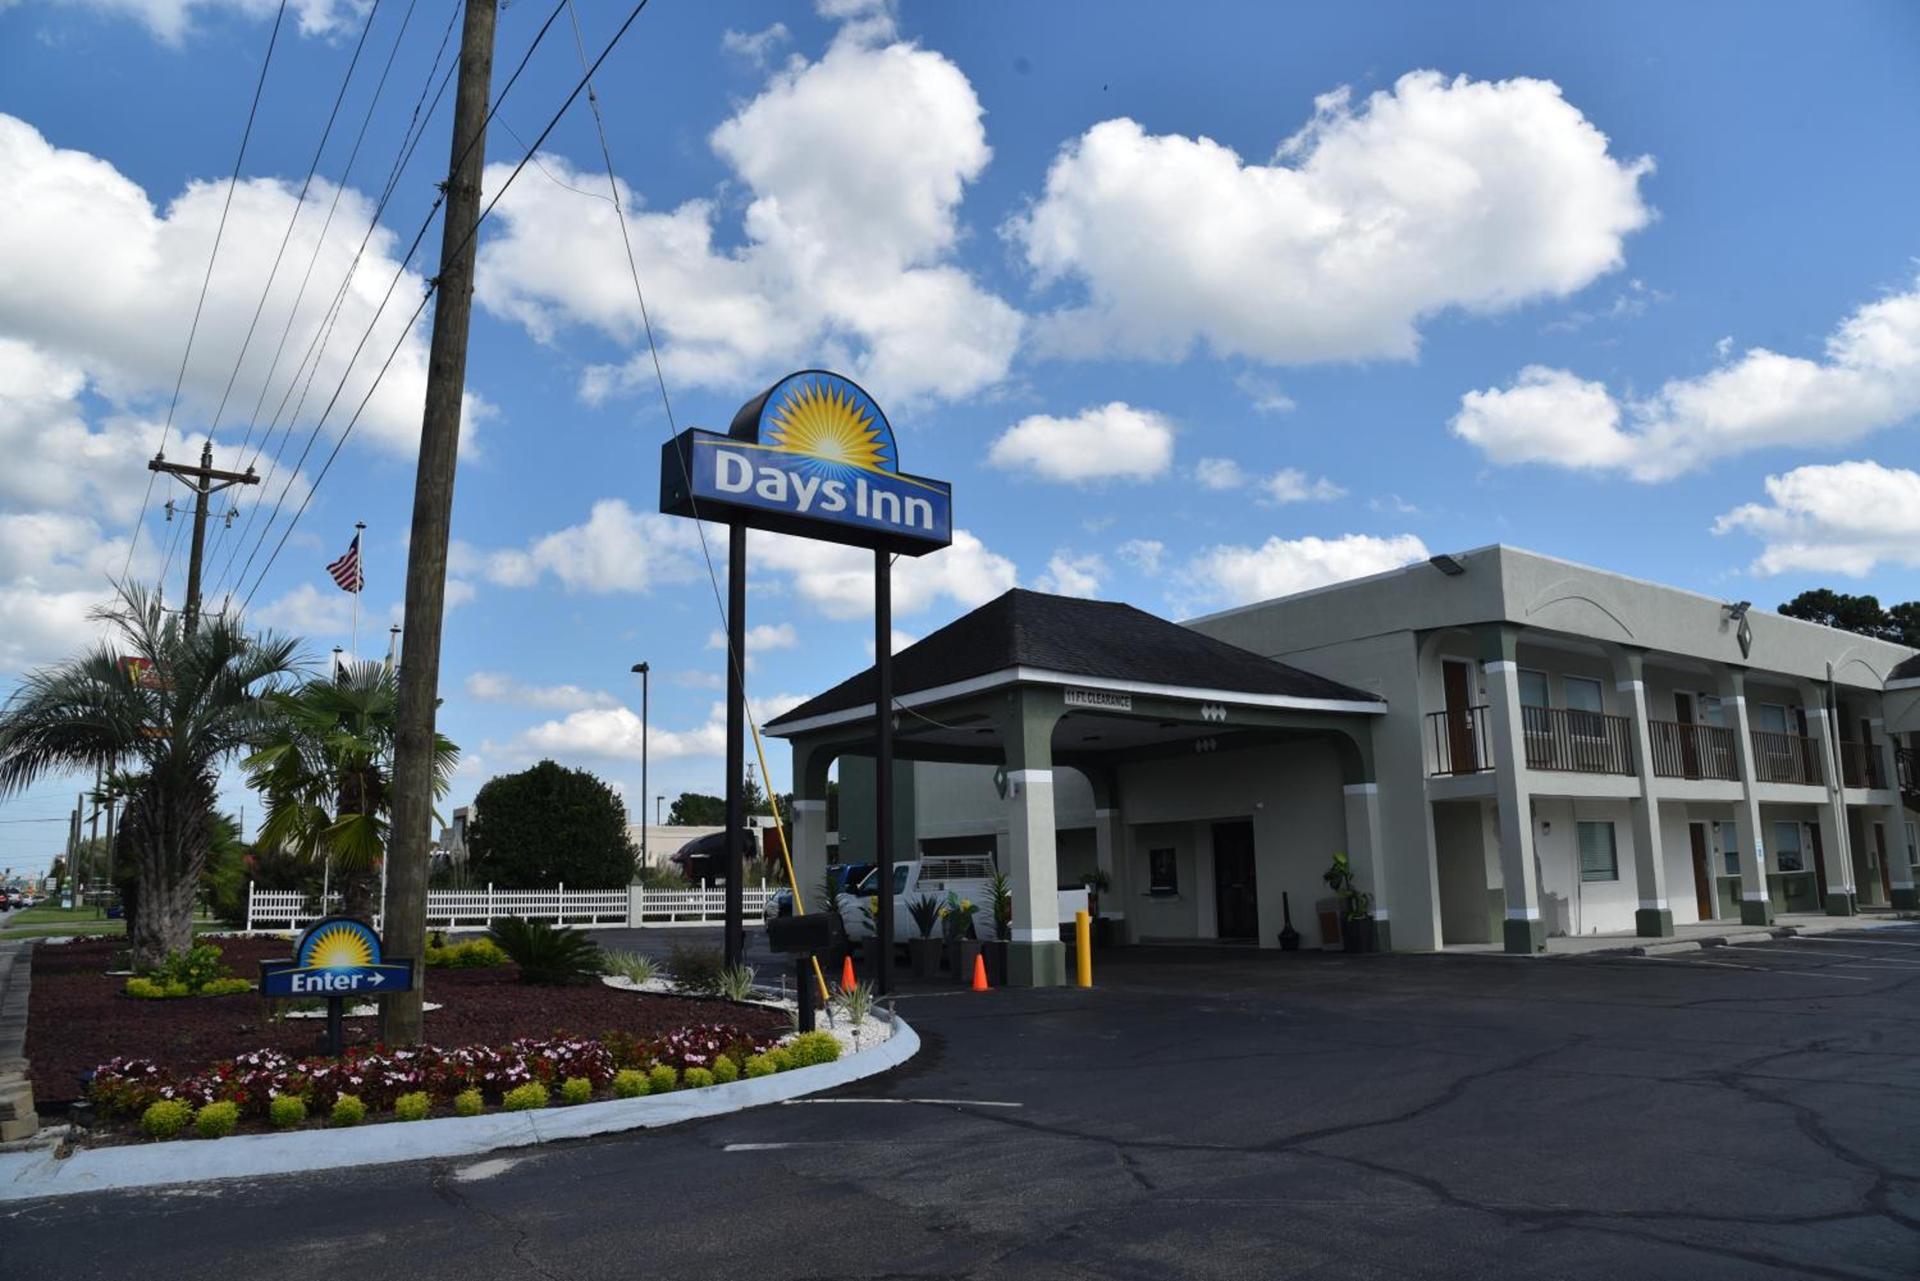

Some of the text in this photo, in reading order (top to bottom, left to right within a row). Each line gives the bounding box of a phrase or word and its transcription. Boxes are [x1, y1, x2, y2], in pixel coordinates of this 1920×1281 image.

[715, 449, 933, 530] Days Inn
[1087, 691, 1132, 708] CLEARANCE
[291, 972, 363, 993] Enter
